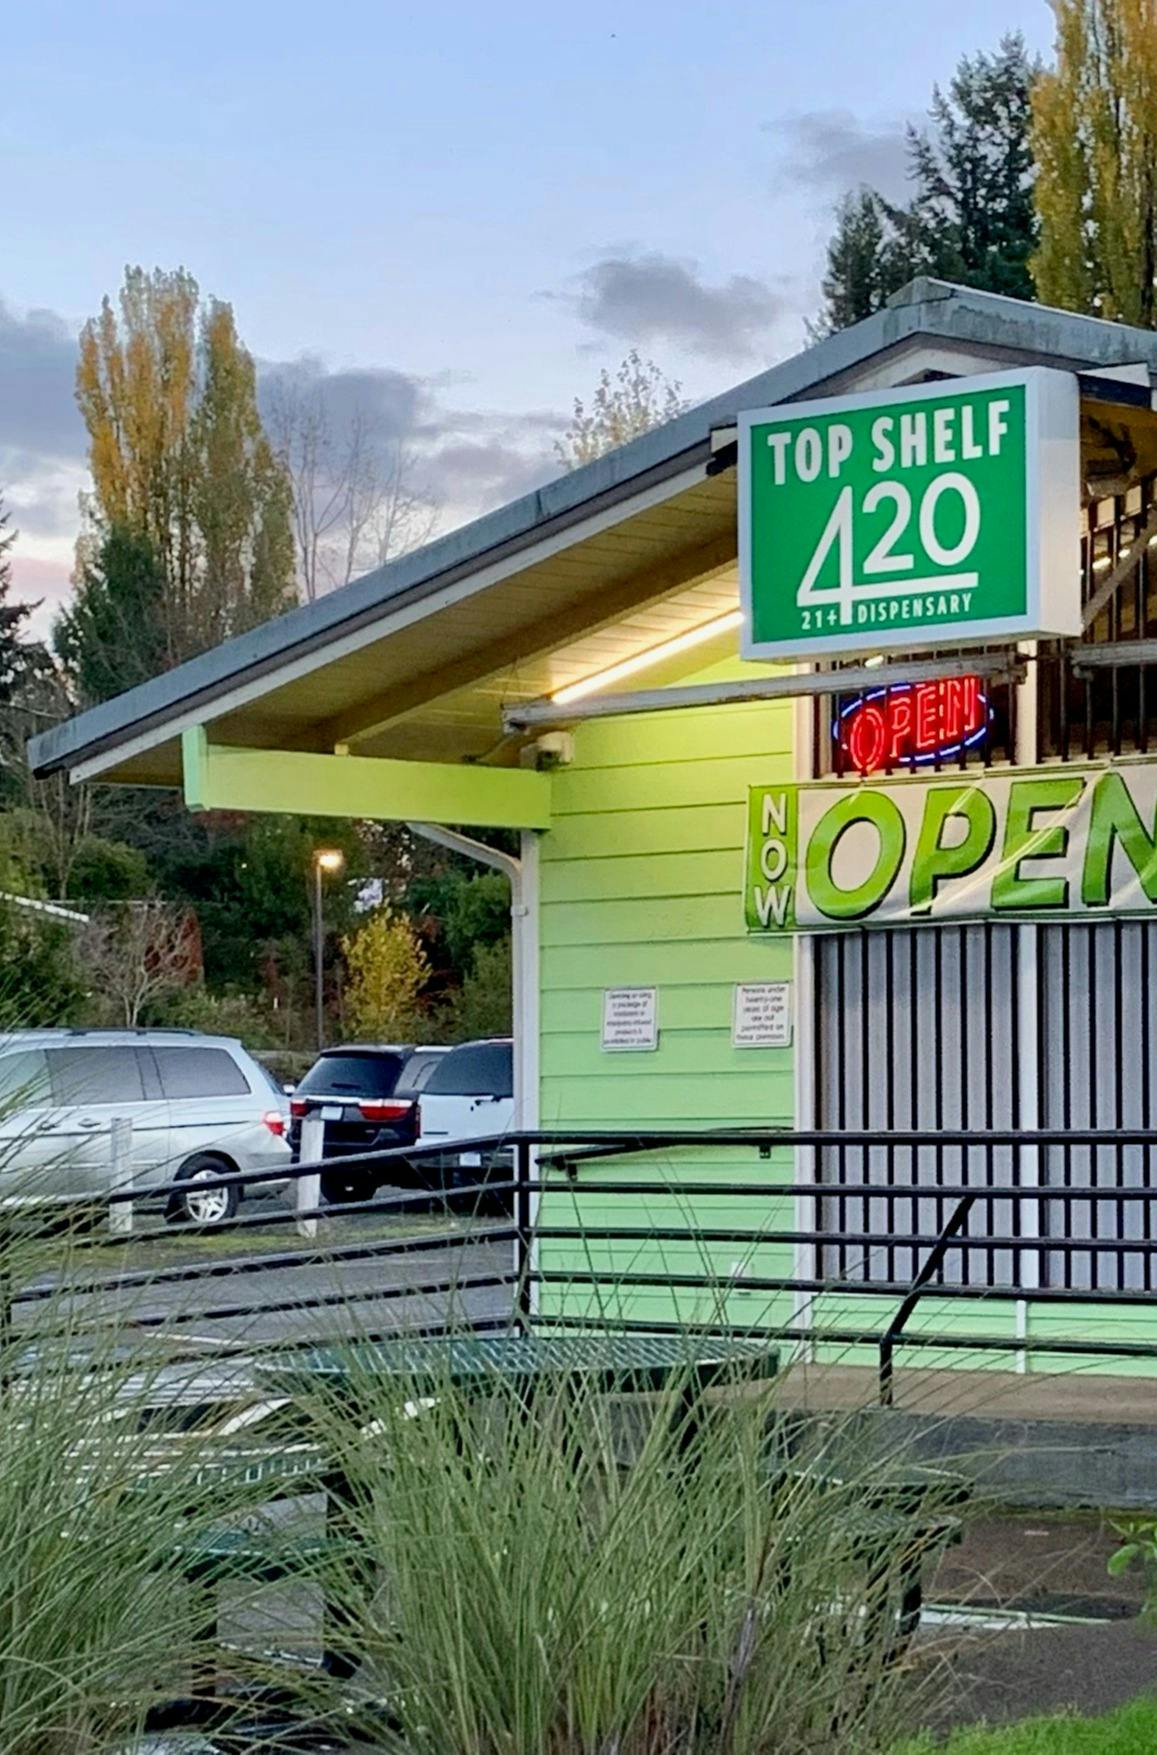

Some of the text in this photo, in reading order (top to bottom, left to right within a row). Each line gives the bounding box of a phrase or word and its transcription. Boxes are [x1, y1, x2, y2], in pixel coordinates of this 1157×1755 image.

[767, 399, 1010, 485] TOP SHELF
[796, 471, 981, 626] 420
[801, 593, 973, 630] 21+ DISPENSARY
[850, 677, 976, 772] OPEN
[754, 792, 793, 929] NOW
